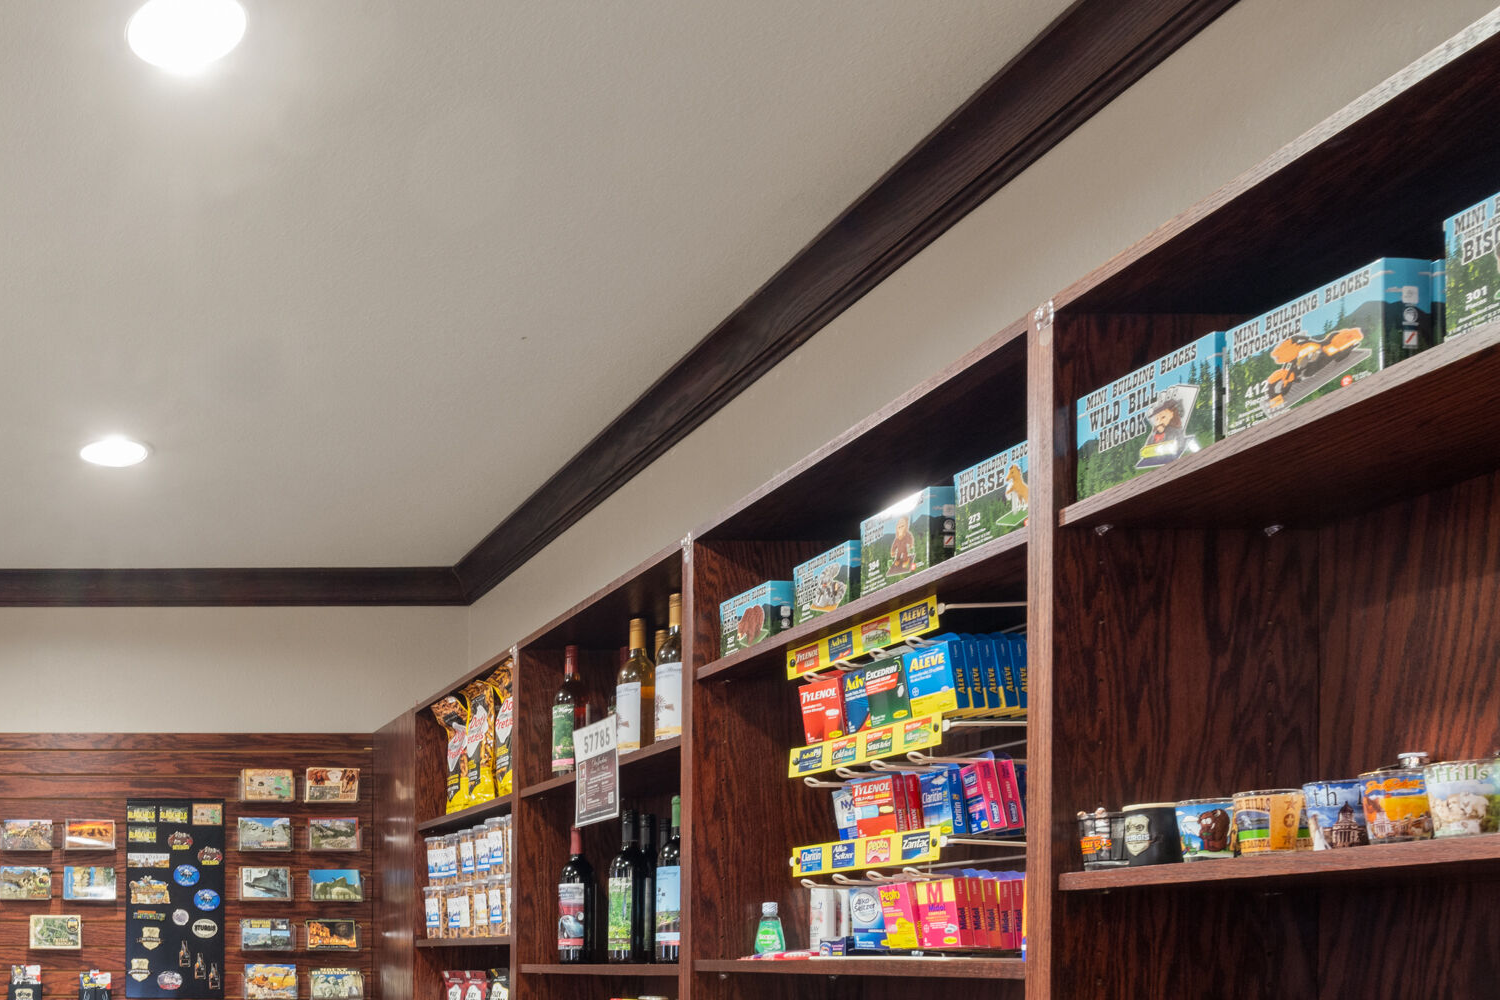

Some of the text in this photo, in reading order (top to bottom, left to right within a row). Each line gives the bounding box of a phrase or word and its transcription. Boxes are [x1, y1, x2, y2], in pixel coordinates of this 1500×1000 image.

[1455, 204, 1487, 236] MINI
[1465, 286, 1488, 303] 301
[1234, 270, 1370, 347] MINI BUILDING BLOCKS
[1233, 319, 1302, 362] MOTORCYCLE
[1086, 343, 1197, 411] MINI BUILDING BLOCKS
[1245, 380, 1269, 399] 412
[1089, 383, 1158, 432] WILD BILL
[1098, 411, 1147, 453] HICKOK
[977, 453, 1008, 477] BUILDING
[959, 468, 1005, 507] HORSE
[901, 606, 928, 624] ALEVE
[831, 634, 848, 648] Advil
[795, 648, 819, 664] TYLENOL
[909, 652, 946, 673] ALEVE
[865, 664, 898, 681] EXCEDRIN
[956, 668, 966, 694] ALEVE
[972, 667, 981, 693] ALEVE
[988, 667, 997, 693] ALEVE
[1004, 666, 1014, 692] ALEVE
[801, 687, 837, 705] TYLENOL
[583, 726, 611, 754] 57785
[1433, 764, 1489, 784] Hills
[853, 782, 891, 797] TYLENOL
[921, 790, 943, 804] Claritin
[954, 801, 964, 827] Claritin
[902, 837, 929, 849] Zantac
[801, 851, 821, 862] Claritin
[834, 851, 854, 861] Seltzer
[880, 889, 900, 902] Pepto
[926, 882, 943, 903] M
[854, 903, 876, 913] Seltzer
[957, 907, 966, 930] Midol
[972, 907, 981, 930] Midol
[987, 908, 996, 931] Midol
[194, 924, 216, 932] STURGIS
[1001, 910, 1009, 933] Midol
[1014, 908, 1022, 932] Midol
